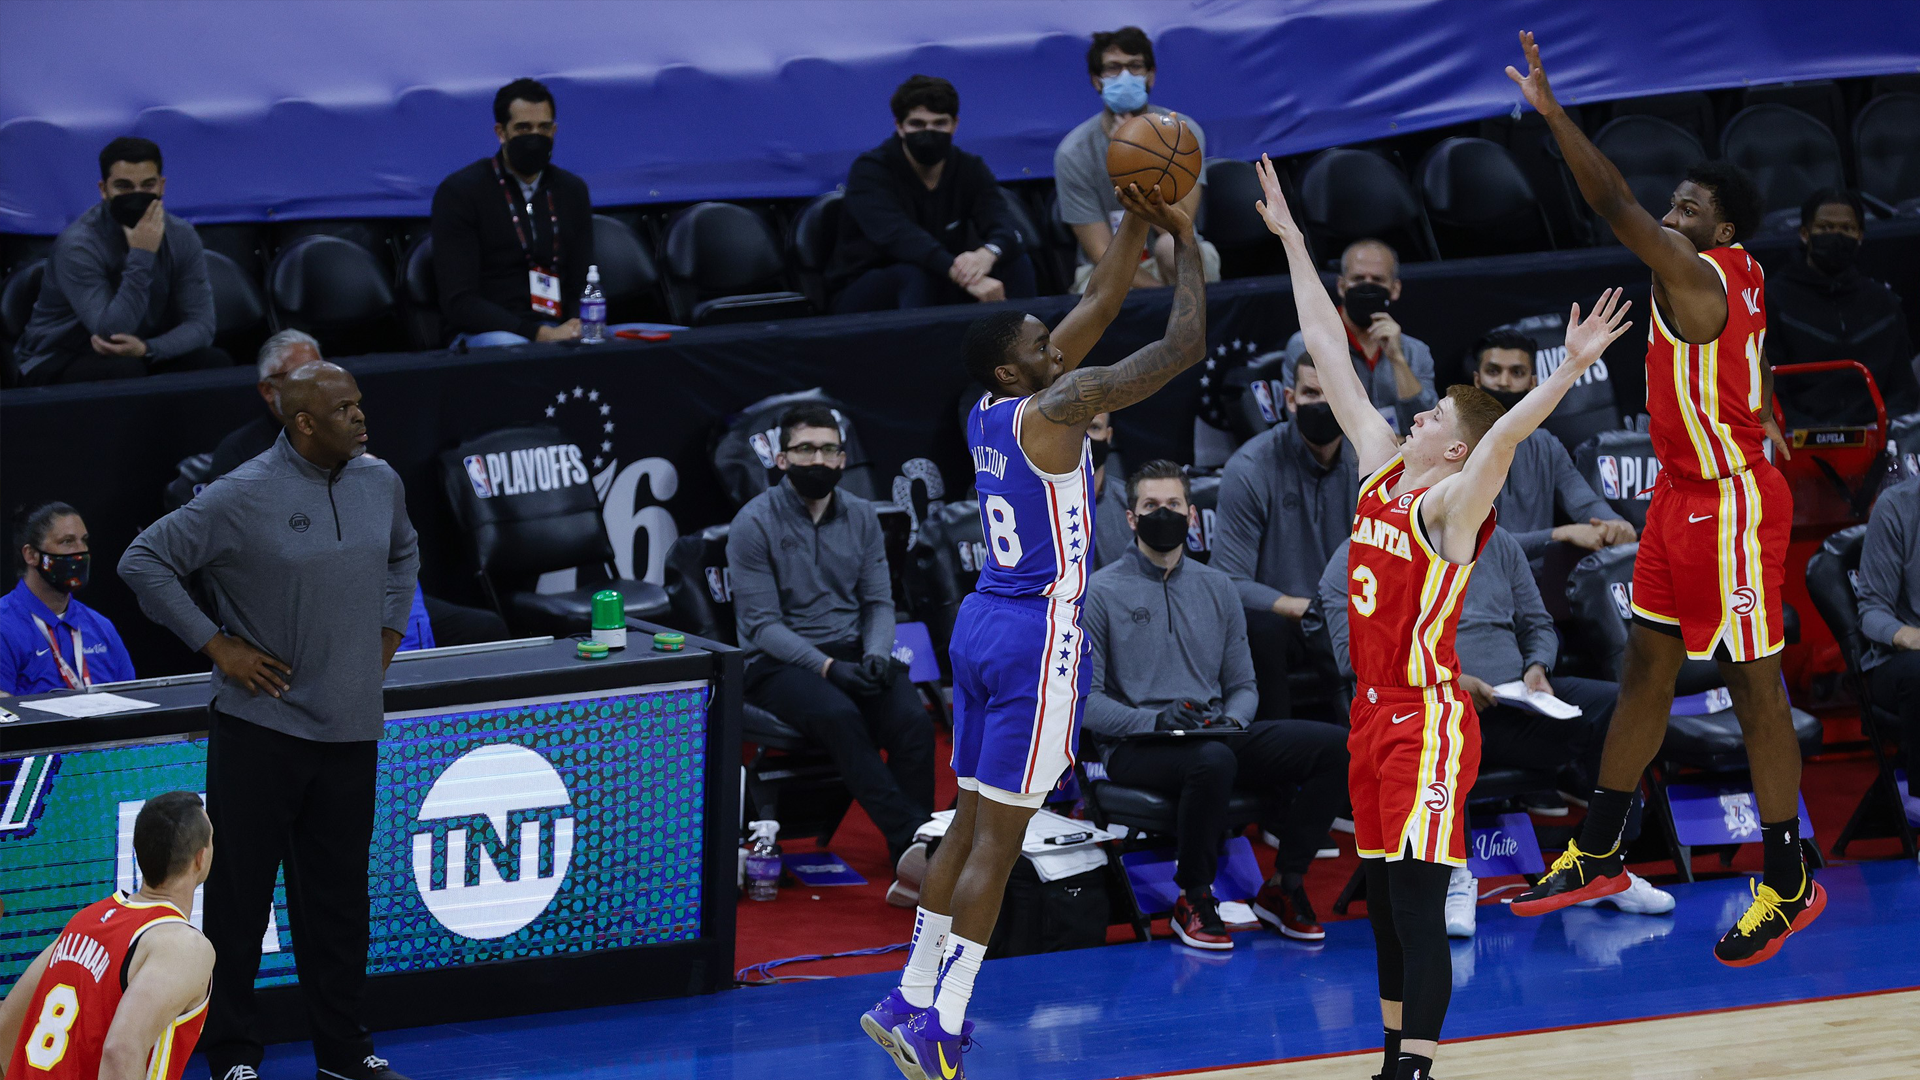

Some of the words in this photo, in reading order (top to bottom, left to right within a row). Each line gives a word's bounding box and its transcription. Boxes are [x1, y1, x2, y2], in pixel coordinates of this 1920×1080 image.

[1745, 327, 1766, 413] 1
[486, 444, 589, 497] PLAYOFFS
[971, 445, 1008, 481] MILTON
[1621, 456, 1663, 500] PLA
[977, 490, 1023, 569] 8
[1352, 564, 1378, 618] 3
[413, 804, 575, 892] TNT
[1476, 831, 1518, 860] Unite
[25, 983, 79, 1072] 8
